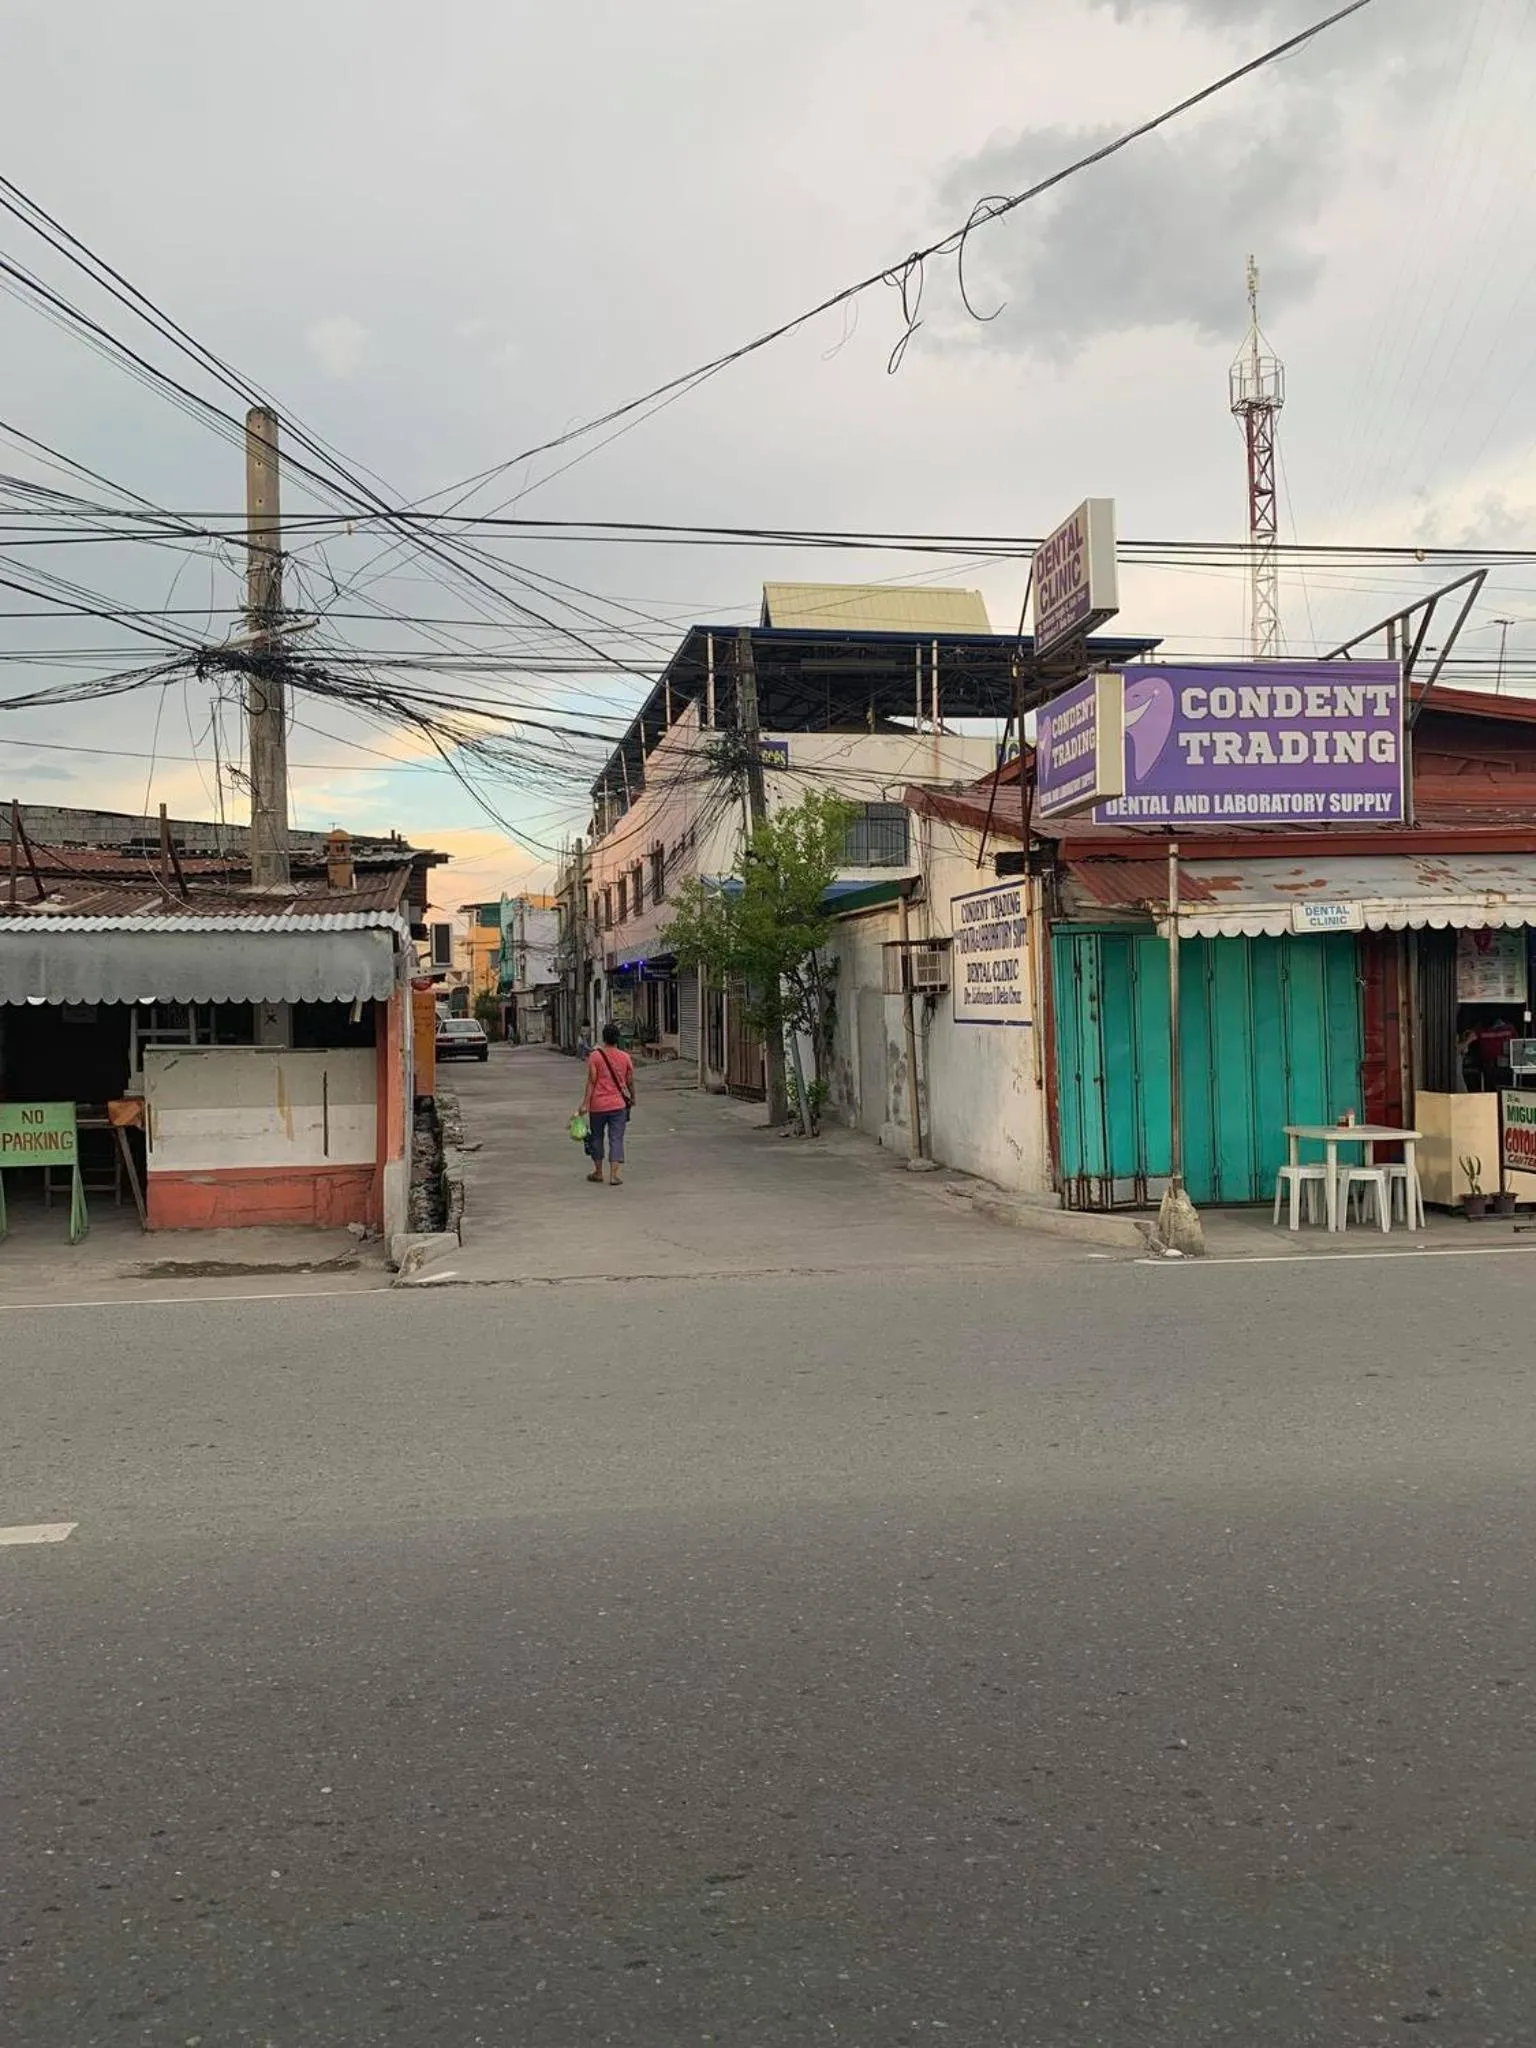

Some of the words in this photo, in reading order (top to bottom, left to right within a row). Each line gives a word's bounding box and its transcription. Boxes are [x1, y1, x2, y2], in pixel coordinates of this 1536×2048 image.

[1036, 517, 1083, 585] DENTAL
[1039, 552, 1081, 615] CLINIC
[1051, 693, 1096, 739] CONDENT
[1180, 684, 1396, 719] CONDENT
[1051, 727, 1096, 769] TRADING
[1178, 730, 1396, 765] TRADING
[1105, 795, 1170, 815] DENTAL
[1173, 794, 1210, 814] AND
[1213, 792, 1326, 814] LABORATORY
[1329, 792, 1392, 813] SUPPLY
[1305, 905, 1350, 917] DENTAL
[1310, 915, 1347, 926] CLINIC
[967, 962, 992, 983] DENTAL
[993, 958, 1019, 982] CLINIC
[21, 1109, 45, 1125] NO
[2, 1131, 74, 1152] PARKING
